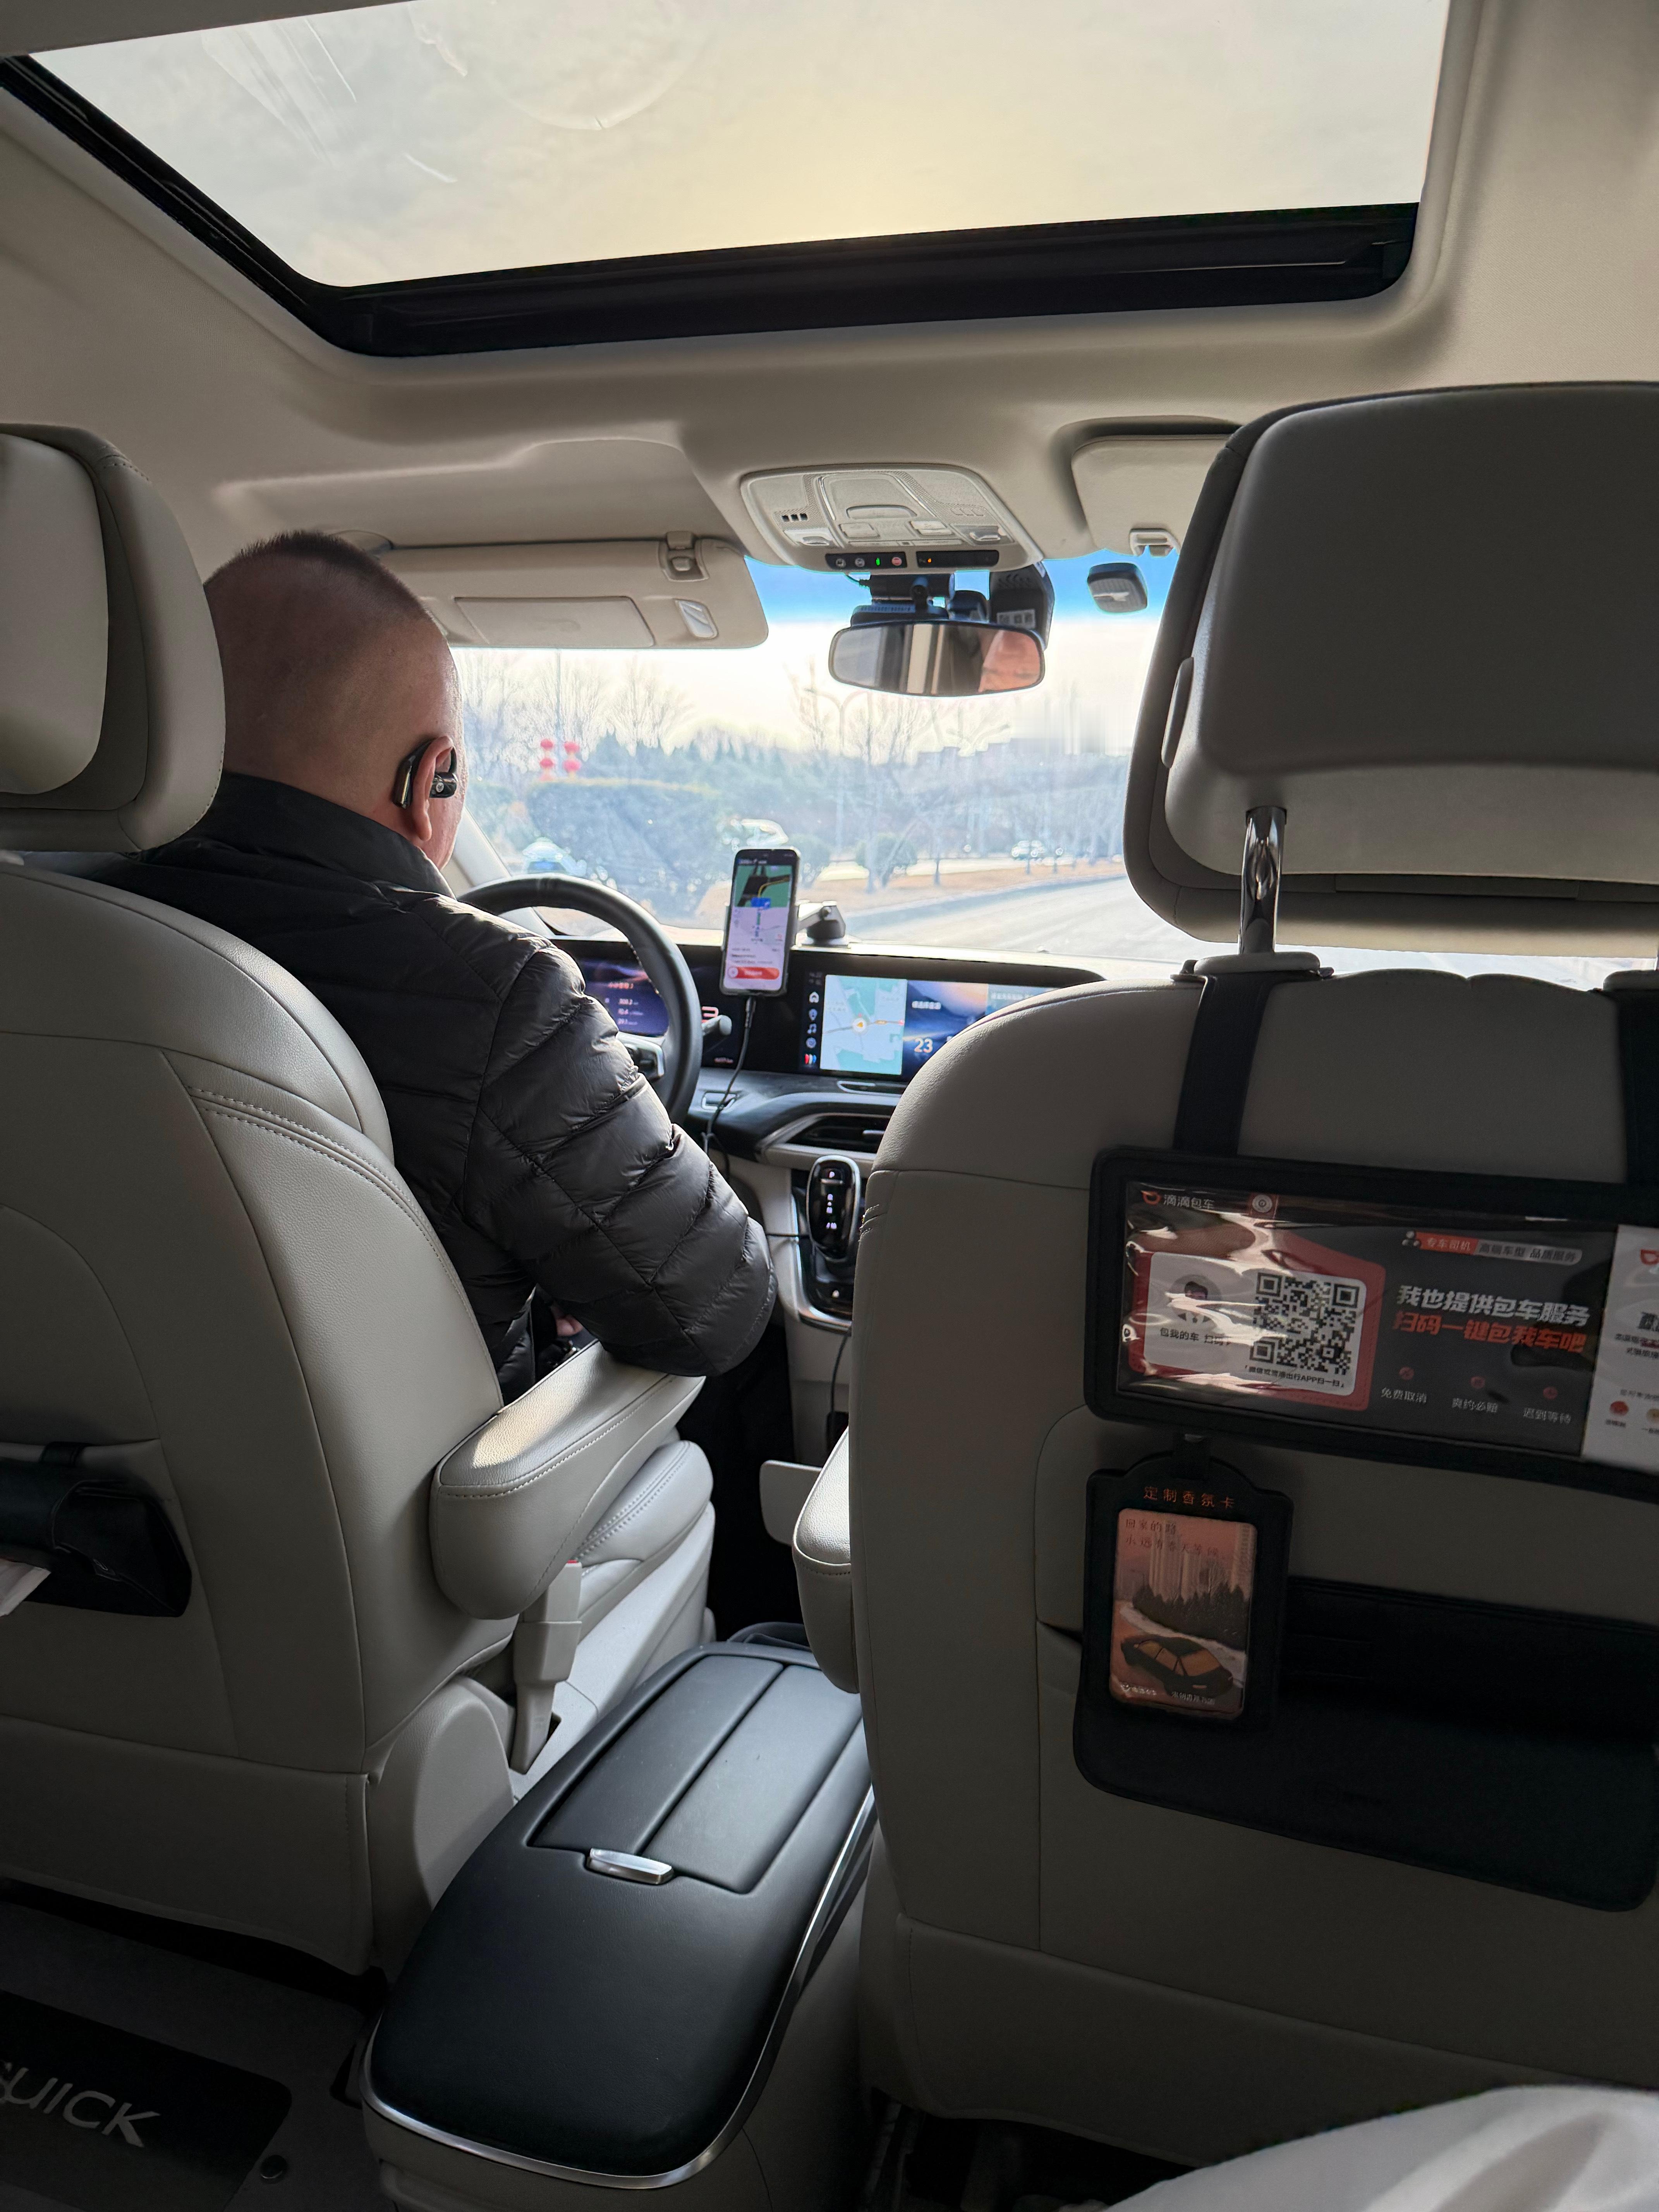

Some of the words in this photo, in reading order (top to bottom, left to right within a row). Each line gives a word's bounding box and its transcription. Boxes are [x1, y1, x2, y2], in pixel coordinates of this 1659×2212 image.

[914, 1037, 933, 1053] 23
[1163, 1194, 1215, 1209] 滴滴包车
[1427, 1237, 1471, 1251] 专车司机
[1529, 1248, 1577, 1262] 品质服务
[1396, 1285, 1590, 1328] 我也提供包车服务
[1160, 1327, 1199, 1341] 包我的车
[1393, 1310, 1588, 1354] 扫码一键包我车吧
[1143, 1486, 1234, 1509] 定制香氛卡
